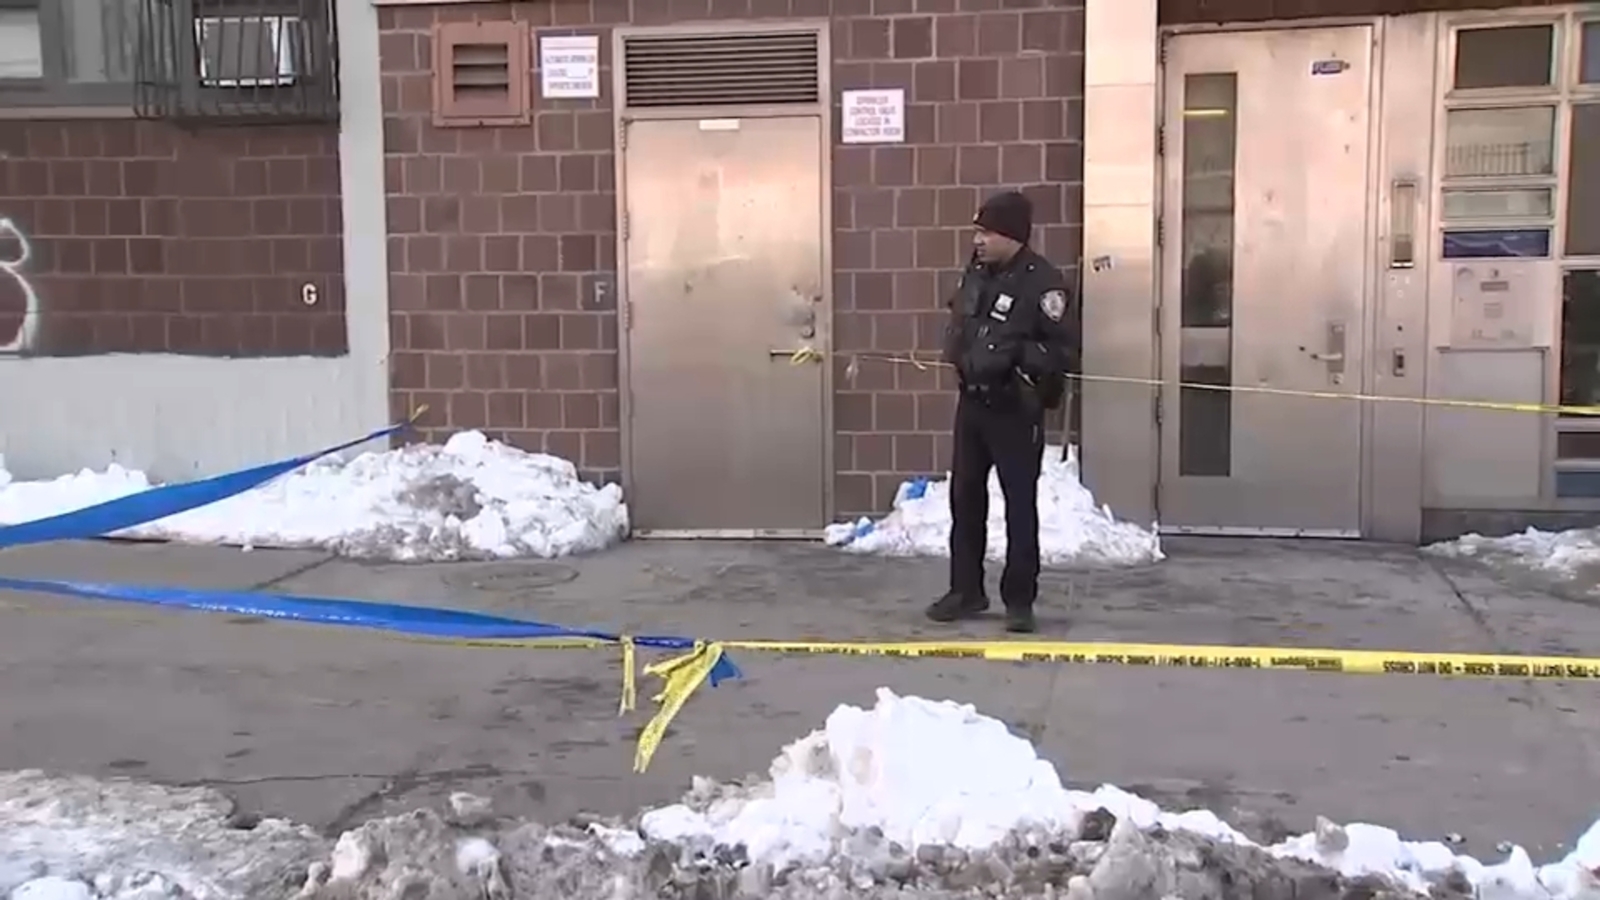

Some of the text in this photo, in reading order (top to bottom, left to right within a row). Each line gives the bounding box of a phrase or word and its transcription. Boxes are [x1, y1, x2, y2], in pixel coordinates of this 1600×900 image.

[303, 283, 317, 305] G
[595, 281, 607, 302] F
[1383, 660, 1415, 674] CROSS
[1417, 660, 1436, 675] NOT
[1438, 660, 1452, 675] DO
[1463, 661, 1495, 675] SCENE
[1497, 662, 1529, 676] CRIME
